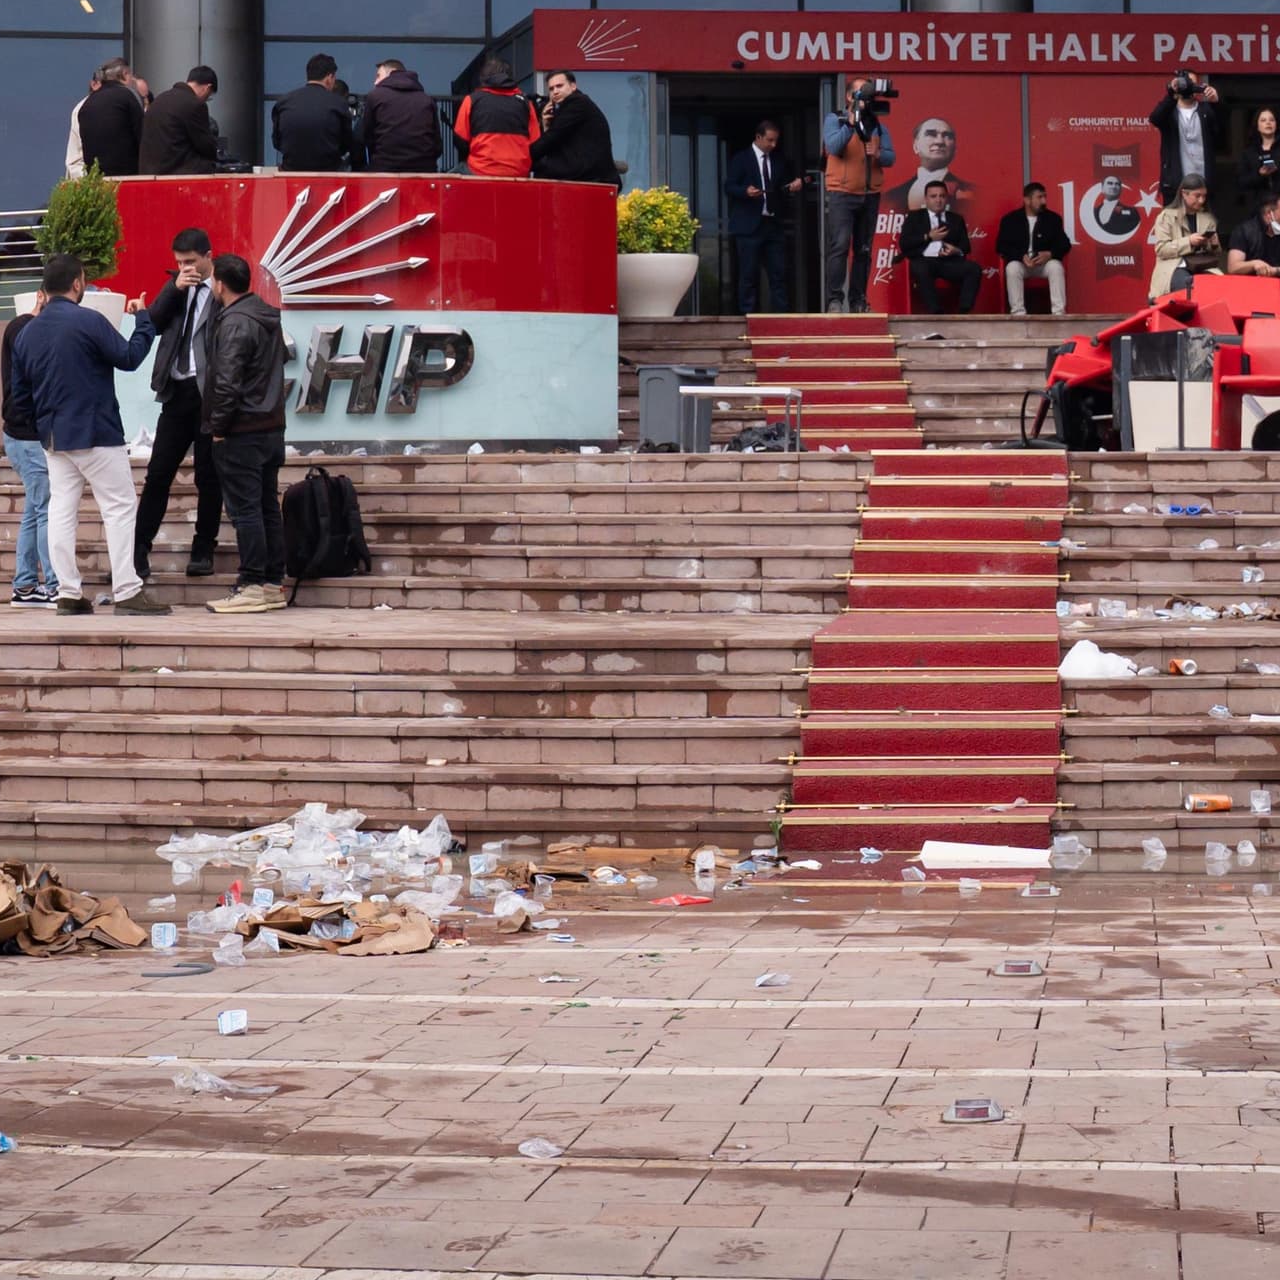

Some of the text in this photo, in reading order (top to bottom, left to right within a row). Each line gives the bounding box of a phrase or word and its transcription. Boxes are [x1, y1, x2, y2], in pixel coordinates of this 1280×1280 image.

[737, 23, 1011, 61] CUMHURİYET
[1029, 33, 1136, 61] HALK
[282, 323, 475, 415] HP
